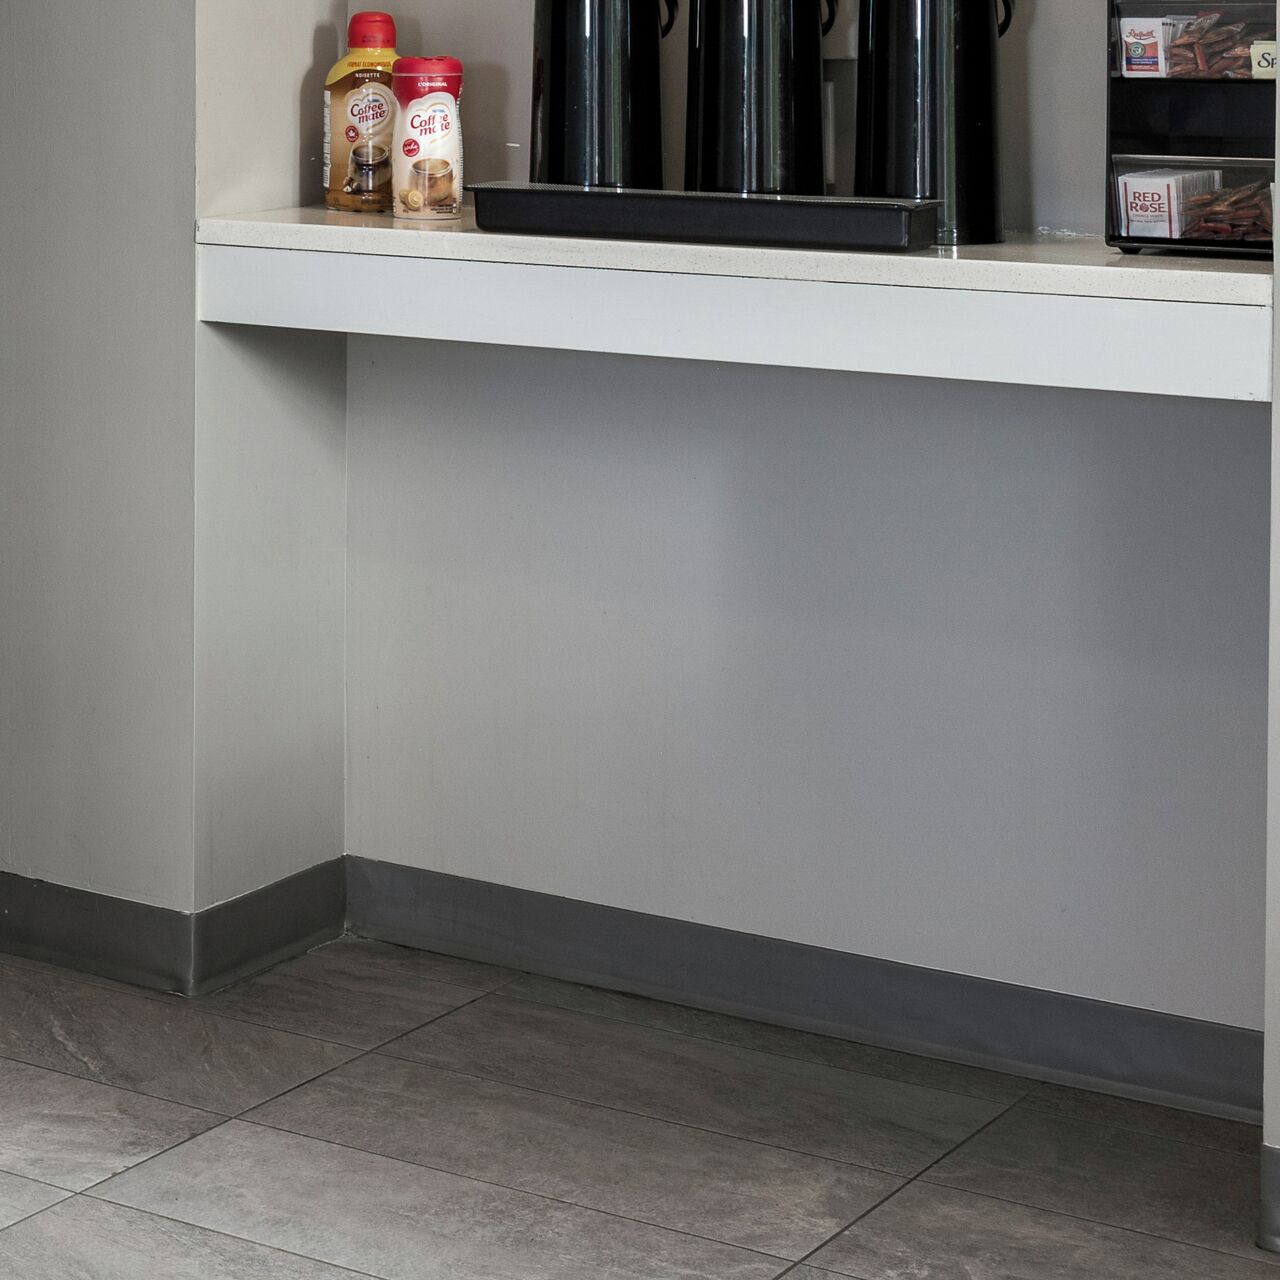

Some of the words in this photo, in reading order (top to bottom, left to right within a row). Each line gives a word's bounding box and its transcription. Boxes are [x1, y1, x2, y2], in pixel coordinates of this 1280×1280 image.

[351, 101, 384, 118] Coffee
[358, 110, 386, 124] mate
[410, 114, 449, 130] Coffe
[1133, 192, 1162, 203] RED
[1130, 202, 1168, 213] ROSE
